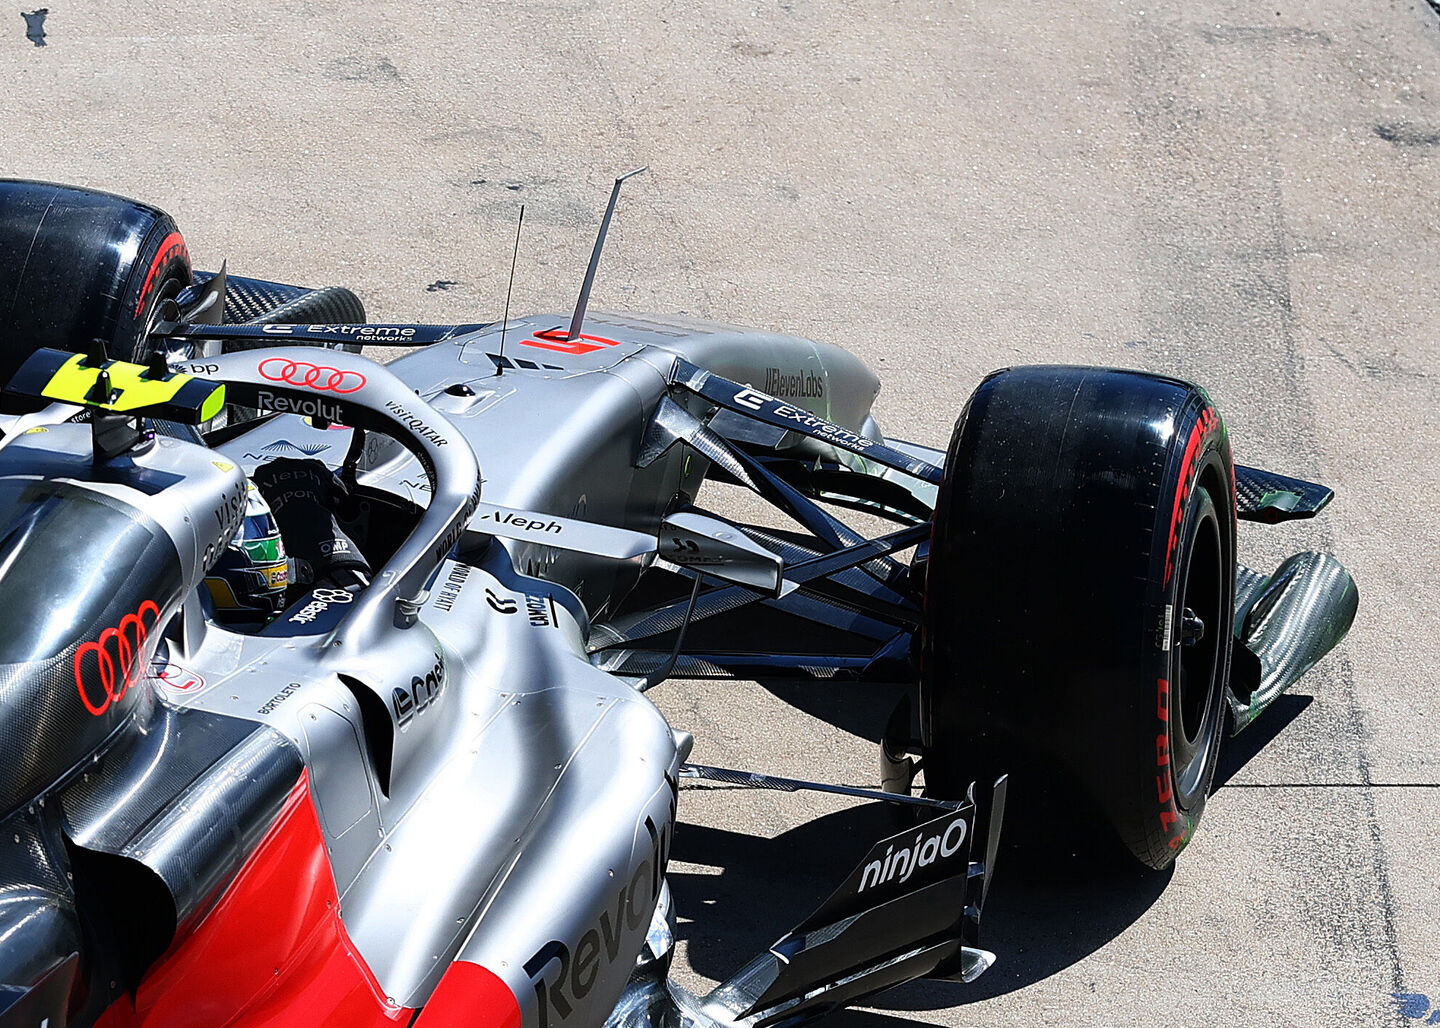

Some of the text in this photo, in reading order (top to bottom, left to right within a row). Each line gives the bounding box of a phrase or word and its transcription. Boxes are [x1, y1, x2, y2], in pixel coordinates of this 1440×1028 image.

[307, 324, 416, 336] Extreme
[355, 334, 413, 342] networks
[191, 362, 219, 376] bp
[258, 391, 344, 424] Revolut
[773, 405, 875, 449] Extreme
[812, 427, 866, 452] networks
[480, 511, 563, 535] Aleph
[257, 682, 301, 715] BORTOLETO
